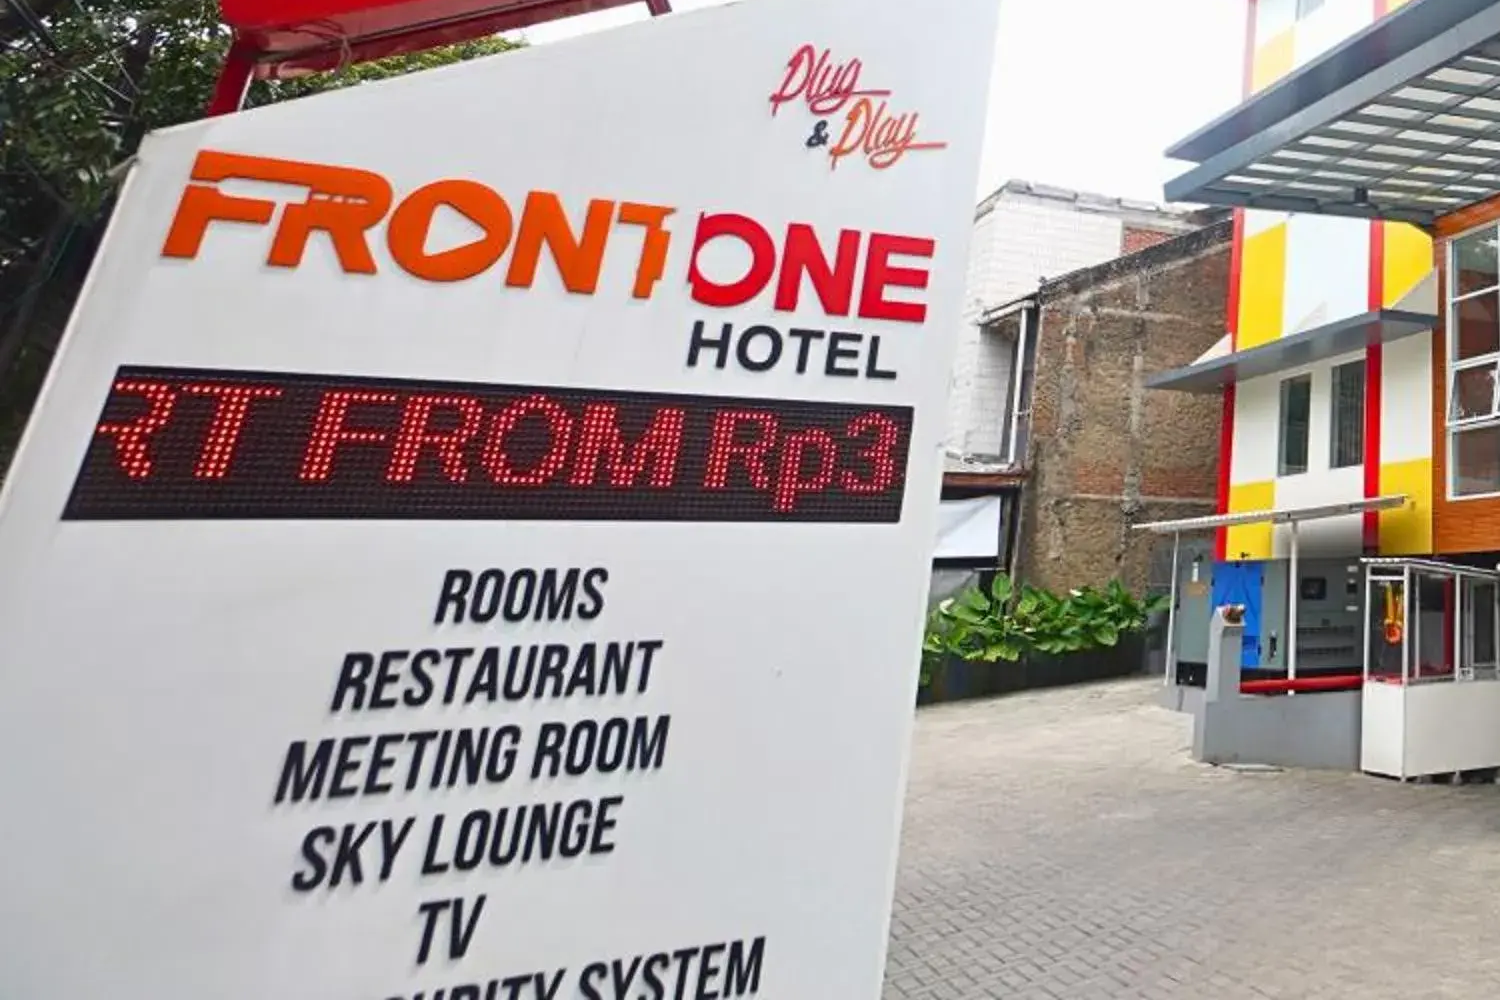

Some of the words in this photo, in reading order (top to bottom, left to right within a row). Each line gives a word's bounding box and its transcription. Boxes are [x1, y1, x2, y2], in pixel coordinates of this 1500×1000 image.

[769, 43, 892, 118] Plug
[806, 119, 830, 148] &
[829, 96, 948, 171] Play
[686, 319, 898, 381] HOTEL
[299, 391, 686, 488] FROM
[703, 409, 899, 514] Rp3
[433, 566, 610, 626] ROOMS
[330, 639, 664, 714] RESTAURANT
[273, 725, 523, 805] MEETING
[531, 714, 672, 780] ROOM
[292, 816, 416, 893] SKY
[421, 795, 625, 876] LOUNGE
[415, 894, 487, 966] TV
[579, 935, 767, 1000] SYSTEM
